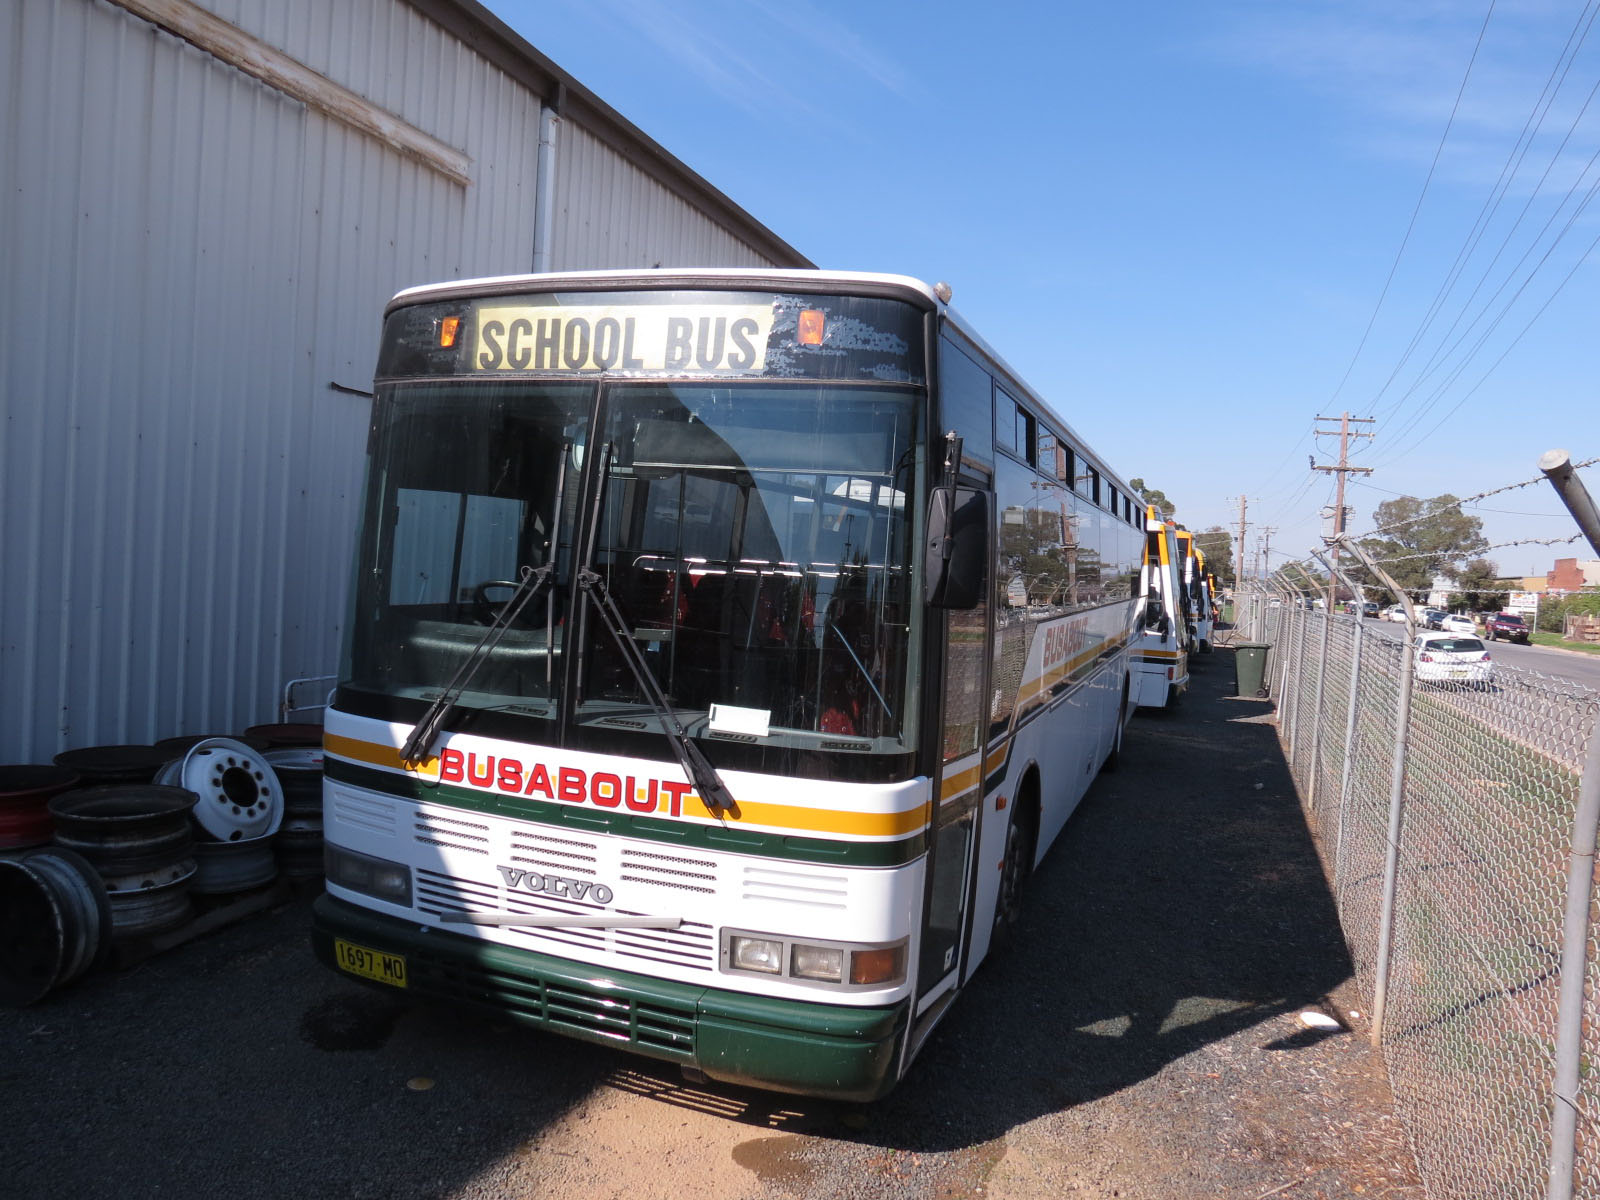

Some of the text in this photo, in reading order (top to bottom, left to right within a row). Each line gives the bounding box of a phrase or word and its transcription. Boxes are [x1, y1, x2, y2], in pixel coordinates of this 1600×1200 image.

[479, 316, 760, 370] SCHOOL BUS
[441, 747, 693, 817] BUSABOUT
[497, 865, 614, 904] VOLVO
